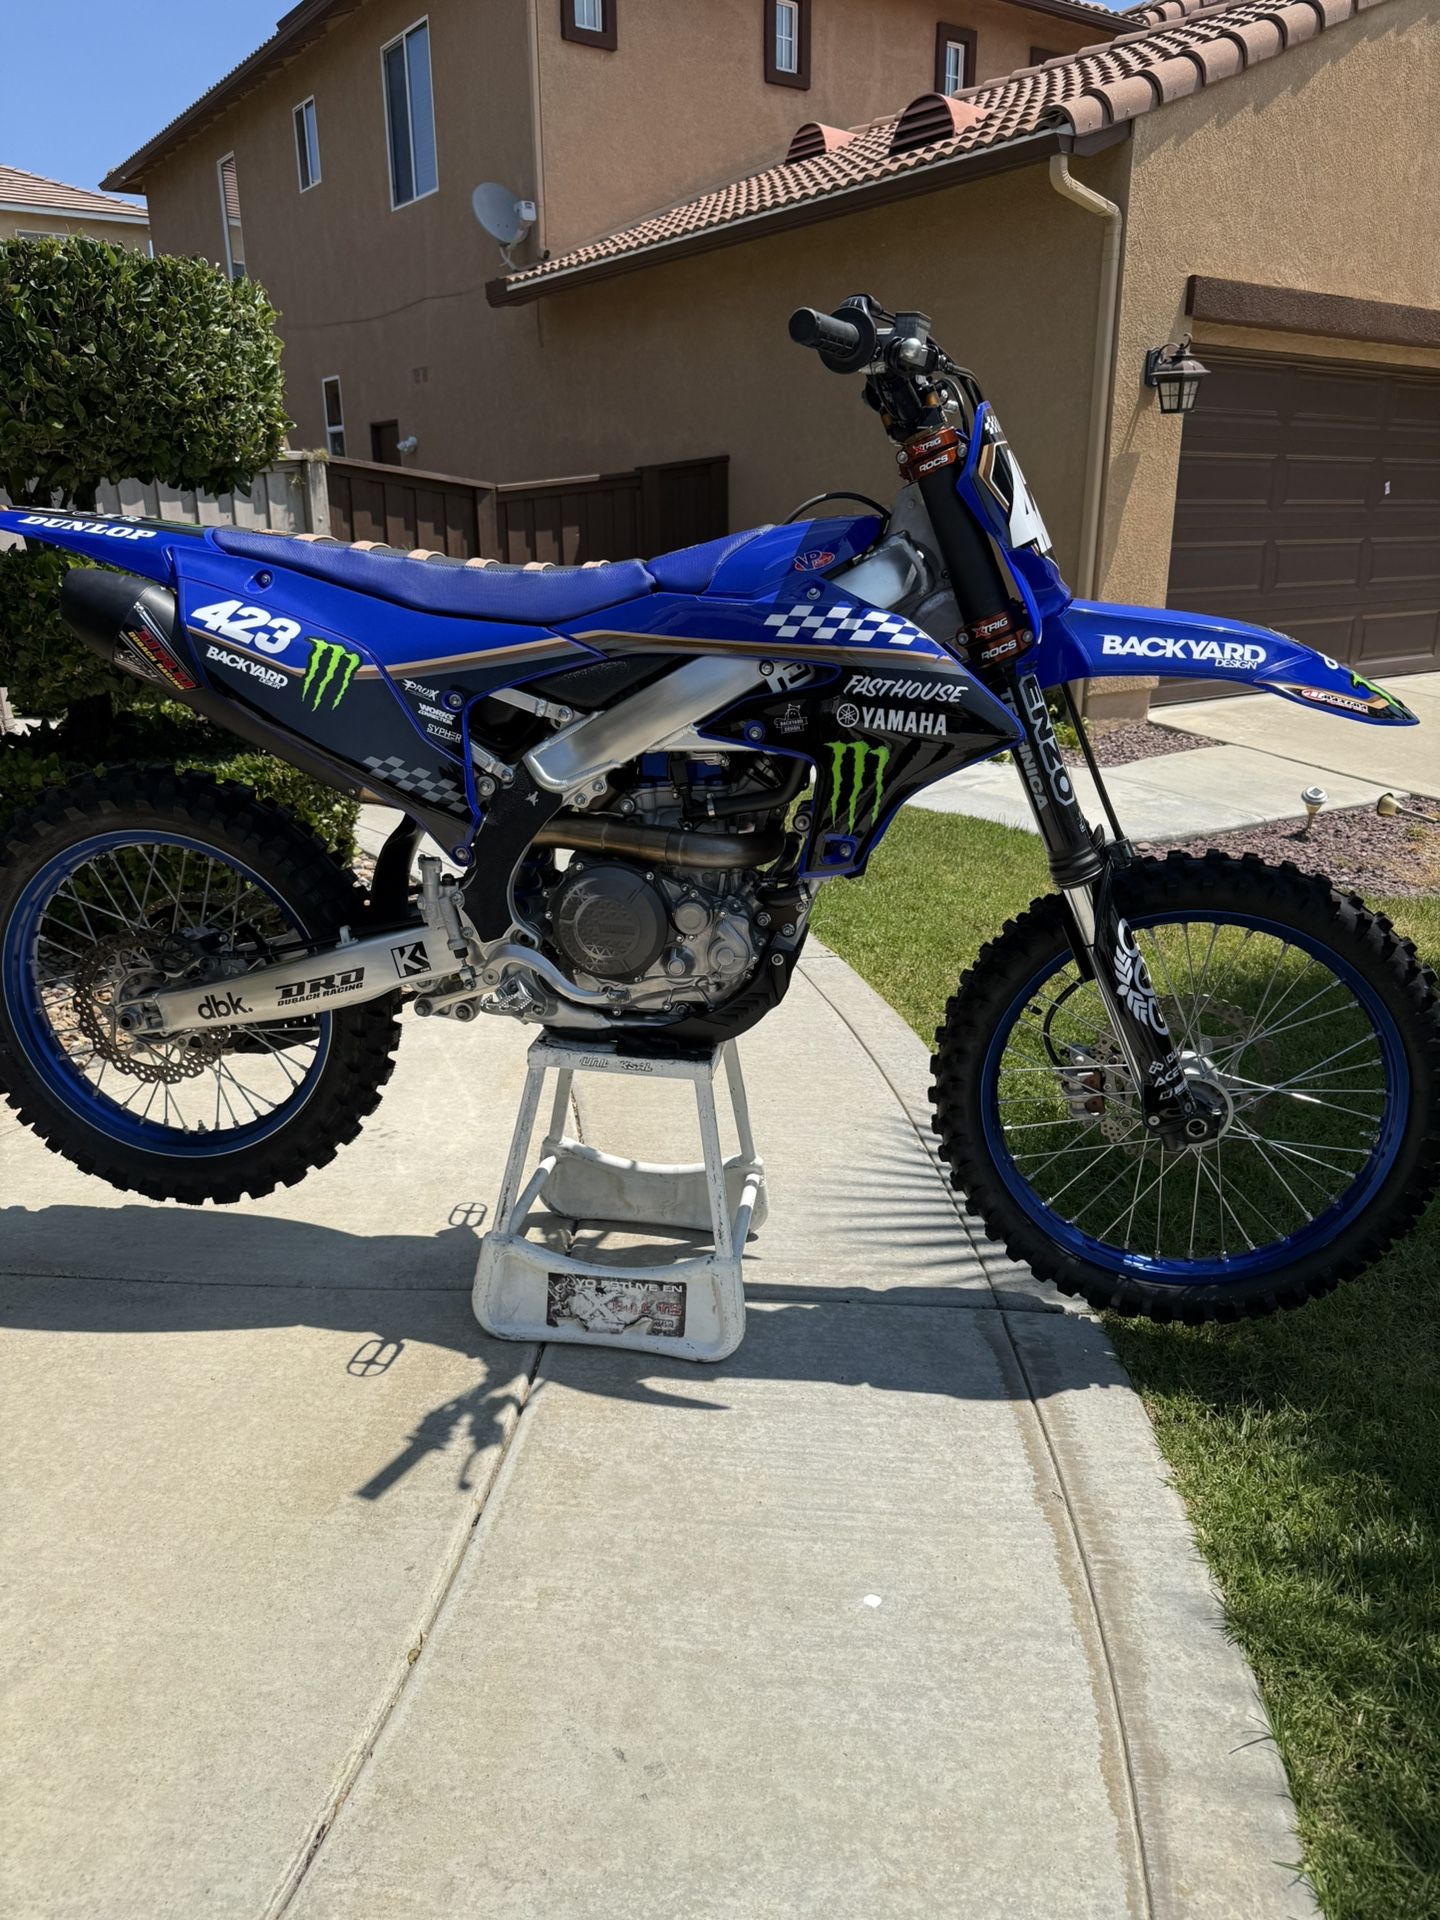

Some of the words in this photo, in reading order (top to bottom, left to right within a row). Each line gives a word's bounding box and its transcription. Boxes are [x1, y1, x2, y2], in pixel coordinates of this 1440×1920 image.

[919, 454, 949, 471] ROCS
[17, 515, 157, 540] DUNLOP
[190, 599, 301, 654] 423
[972, 617, 1008, 638] XTRIG
[981, 639, 1017, 660] ROCS
[1097, 633, 1267, 664] BACKYARD
[206, 644, 288, 687] BACKYARD
[1215, 657, 1258, 670] DESIGN
[843, 675, 969, 702] FASTHOUSE
[418, 702, 457, 721] WORKS
[862, 706, 947, 736] YAMAHA
[426, 723, 462, 743] SYPHER
[1019, 672, 1076, 806] ENZO
[197, 992, 253, 1020] dbk.
[277, 992, 320, 1007] DUBACH
[322, 982, 363, 997] RACING
[576, 1278, 597, 1289] YO
[662, 1284, 683, 1293] EN
